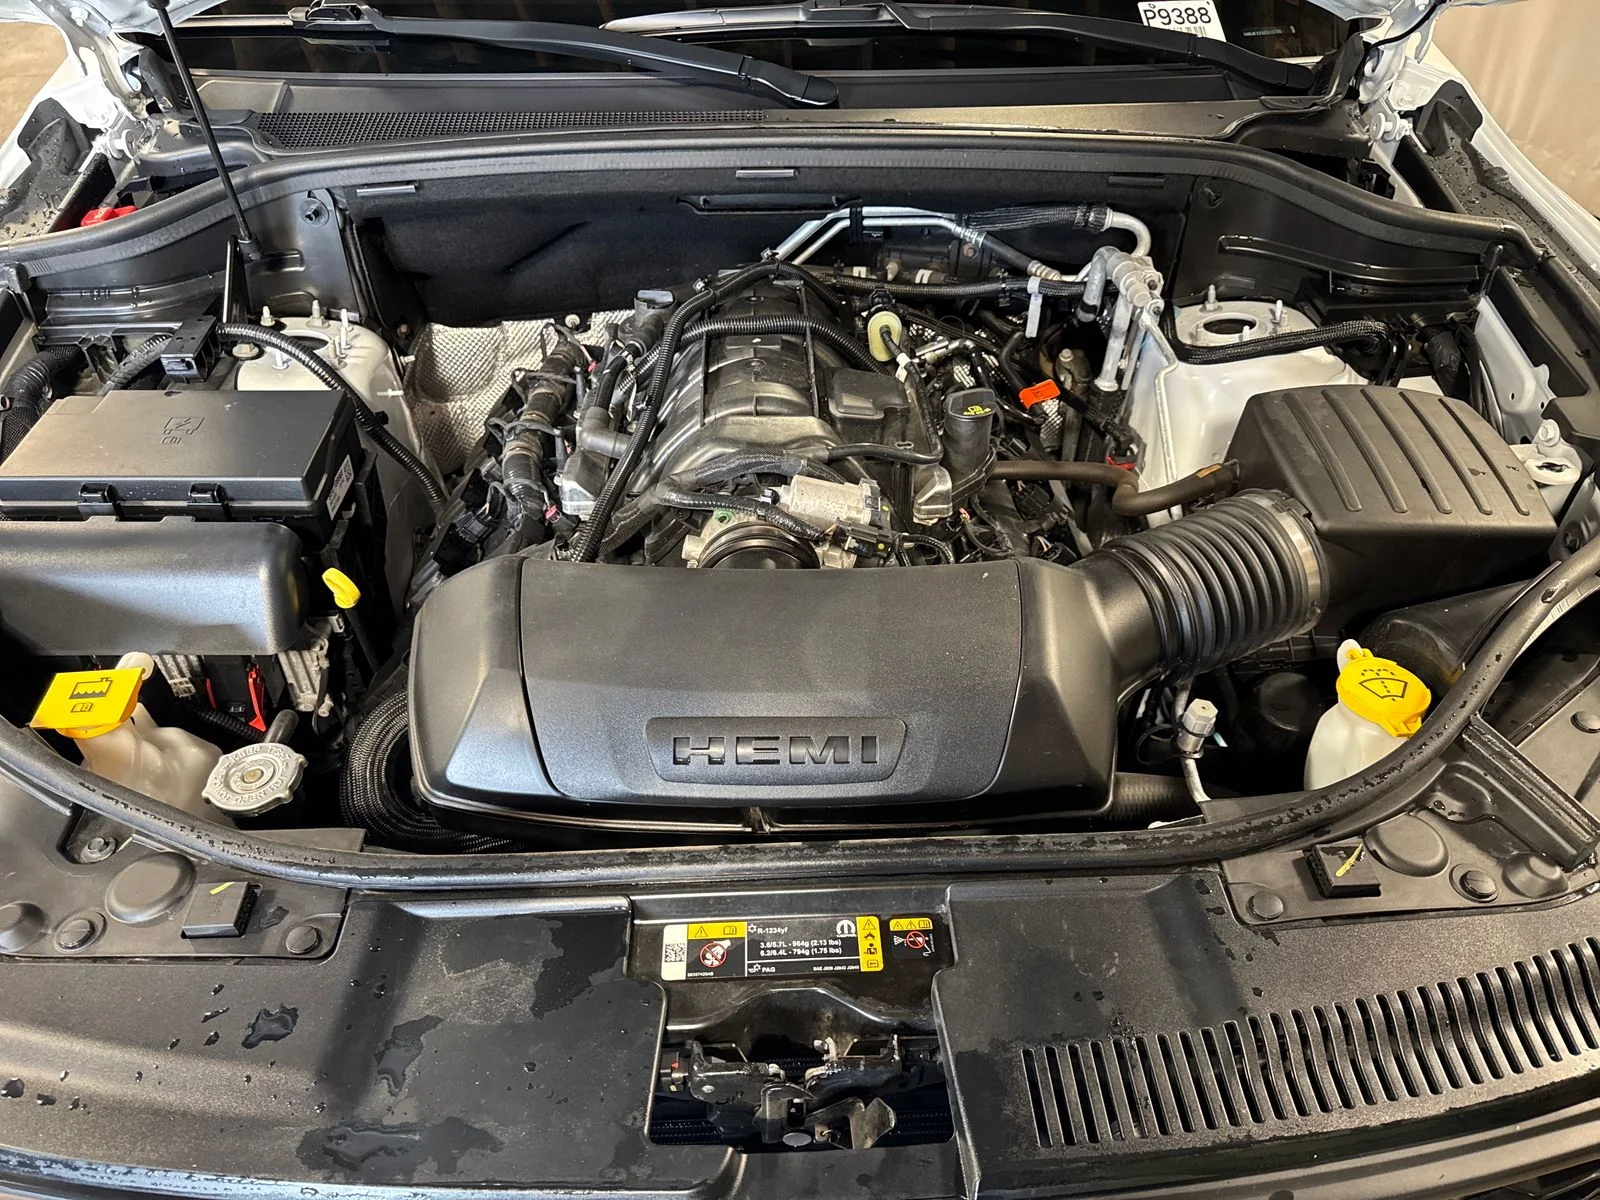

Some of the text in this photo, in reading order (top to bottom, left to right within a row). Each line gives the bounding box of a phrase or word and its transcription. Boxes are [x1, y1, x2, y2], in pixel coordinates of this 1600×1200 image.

[1143, 7, 1212, 26] P9388
[673, 736, 878, 765] HEMI
[758, 927, 788, 936] R-1234yf
[760, 941, 787, 949] 3.6/5.7L
[811, 940, 827, 948] (2.13
[829, 947, 842, 955] lbs)
